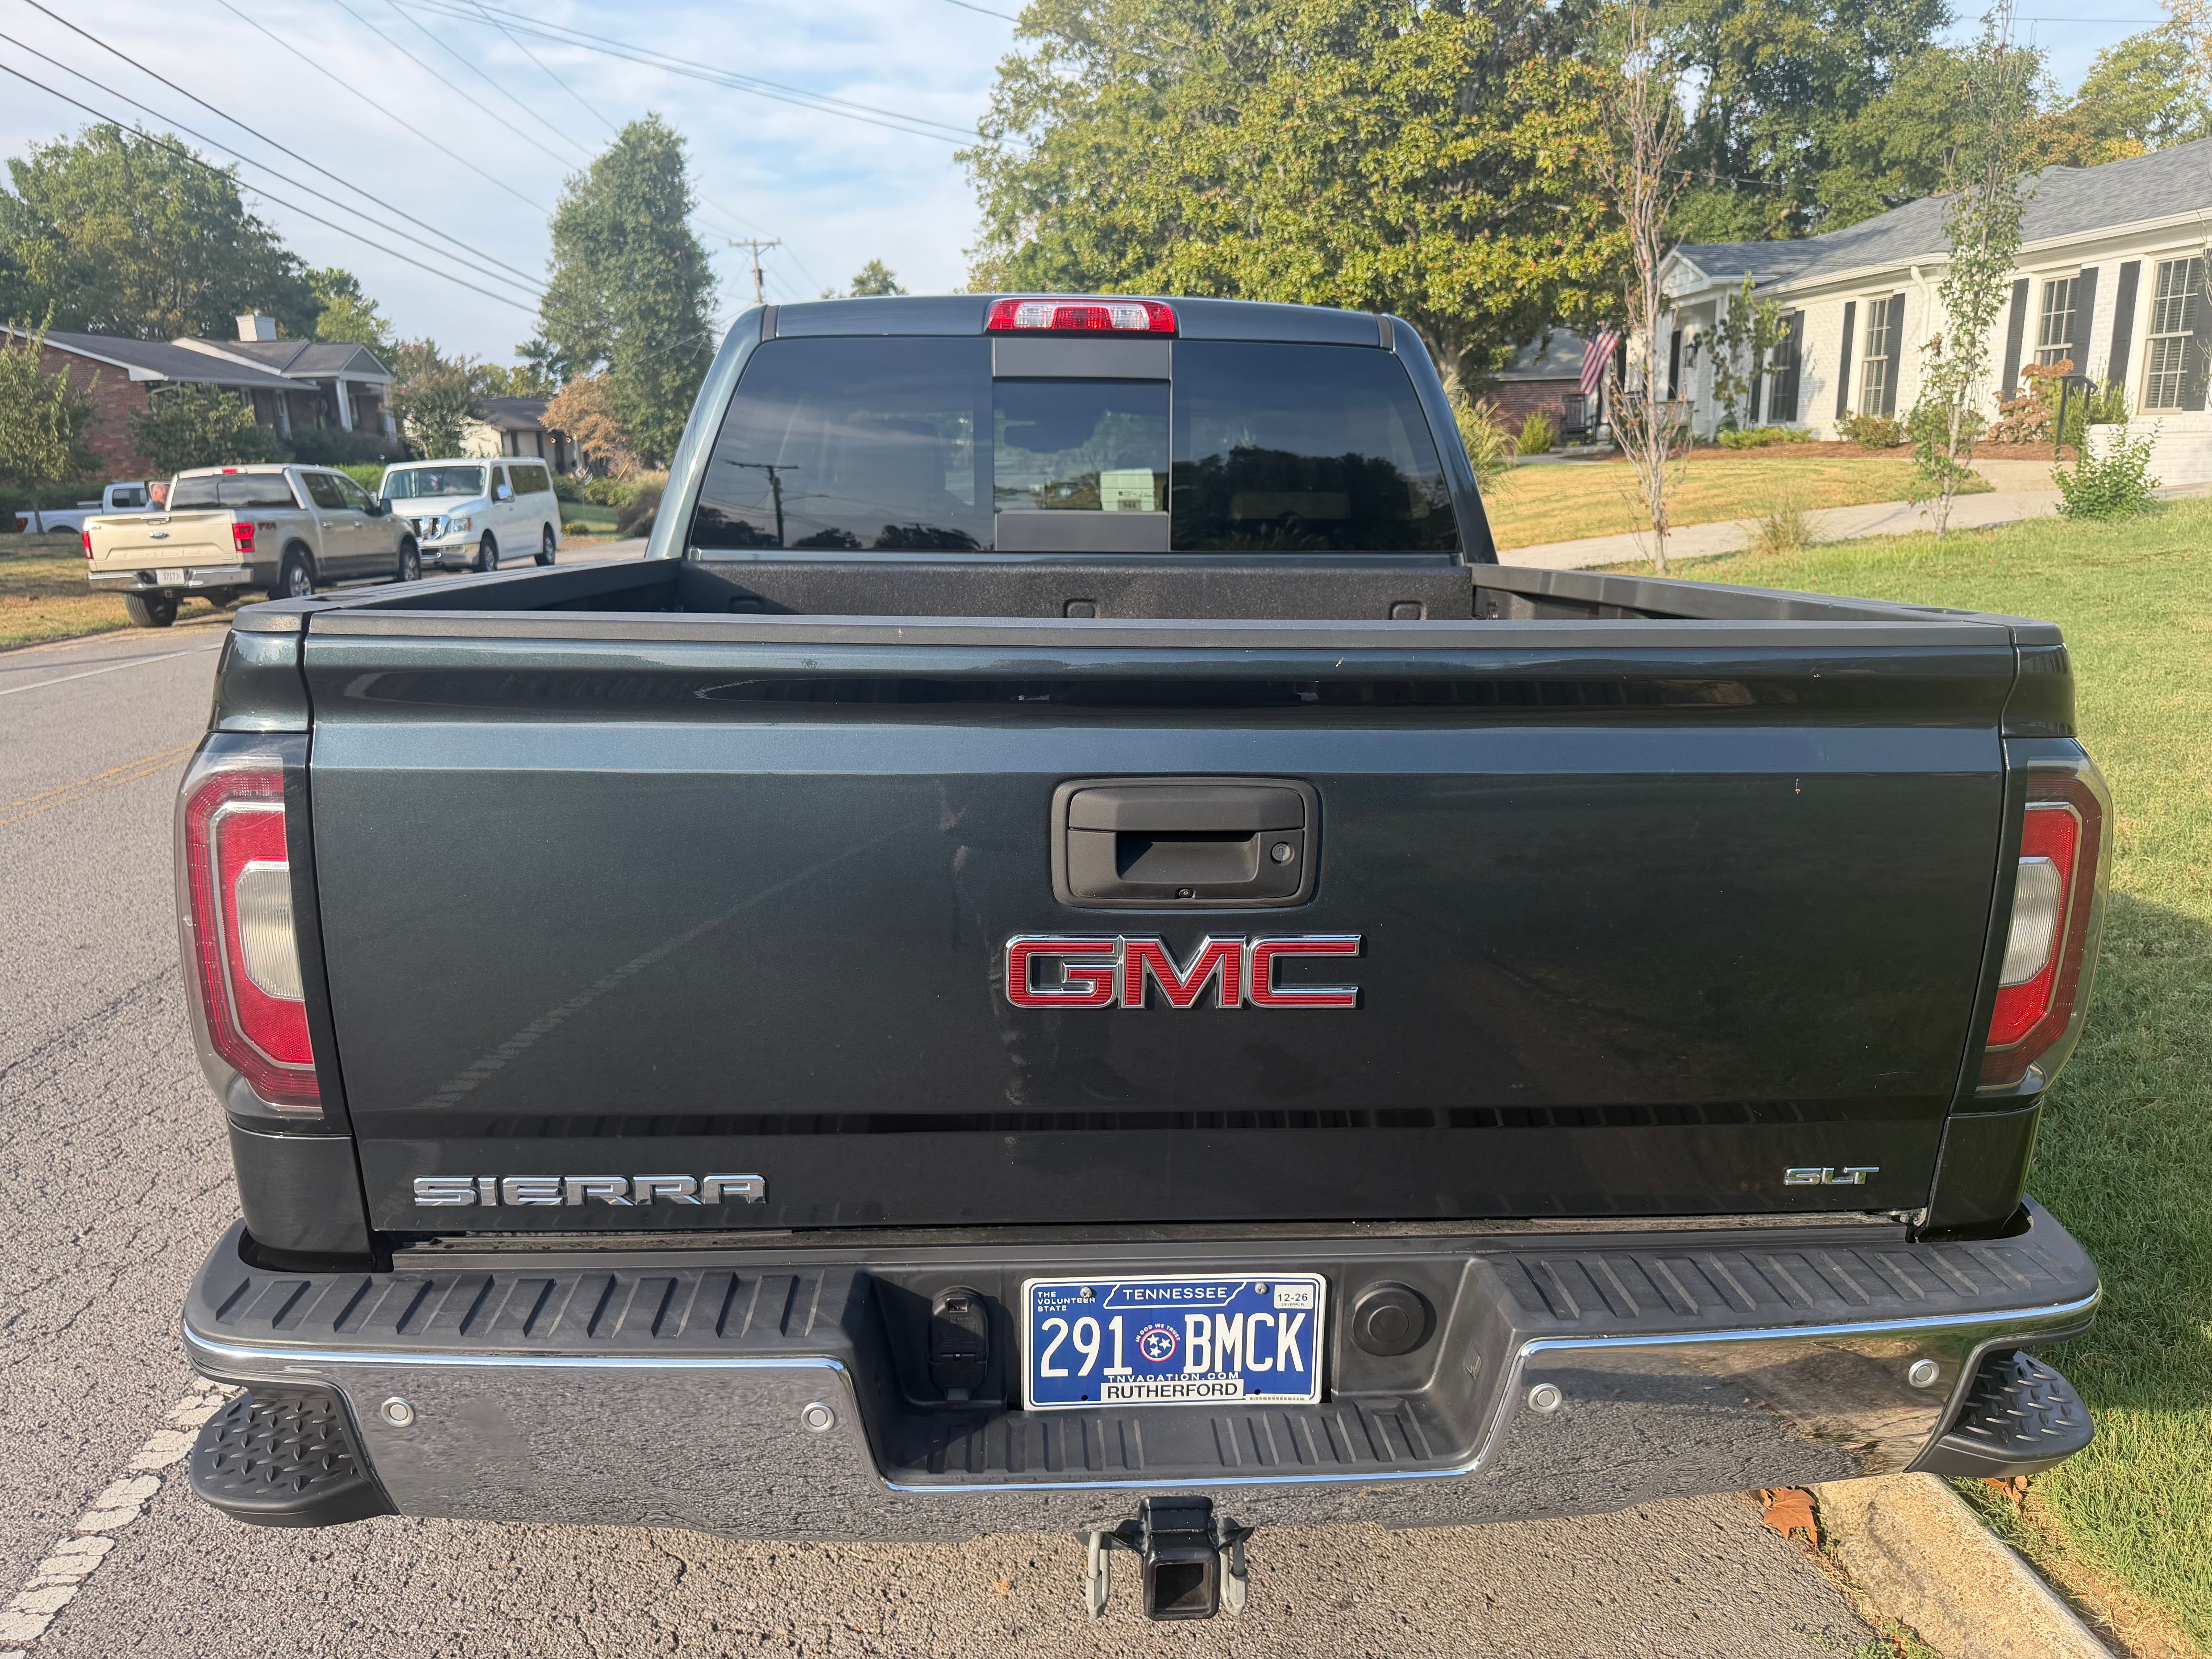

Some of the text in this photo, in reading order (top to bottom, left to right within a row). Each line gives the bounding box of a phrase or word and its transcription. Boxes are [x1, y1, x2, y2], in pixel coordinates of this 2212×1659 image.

[1006, 933, 1362, 1009] GMC
[1783, 1166, 1880, 1185] SLT
[414, 1175, 767, 1207] SIERRA
[1123, 1287, 1227, 1300] TENNESSEE
[1278, 1293, 1308, 1302] 12-26
[1166, 1325, 1181, 1341] TRUST
[1041, 1313, 1306, 1377] 291 BMCK
[1108, 1372, 1239, 1383] TNVACATION.COM
[1108, 1383, 1238, 1399] RUTHERFORD
